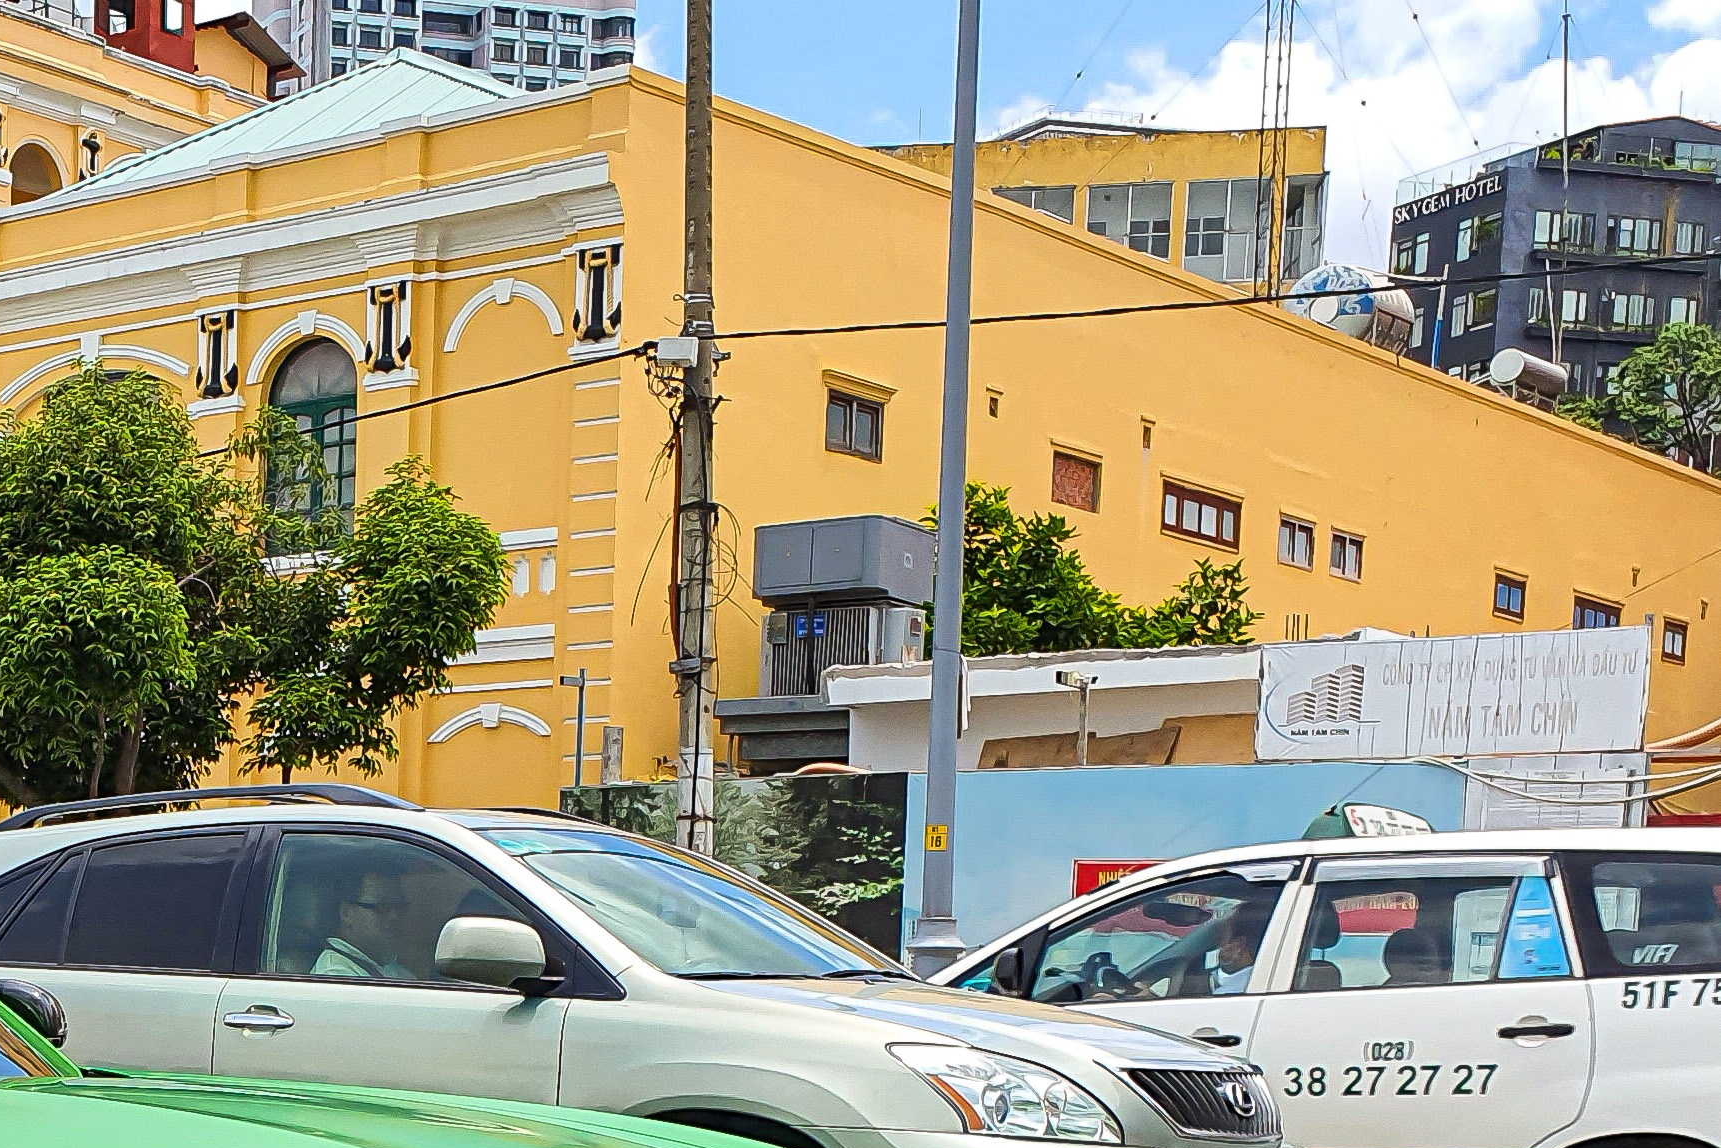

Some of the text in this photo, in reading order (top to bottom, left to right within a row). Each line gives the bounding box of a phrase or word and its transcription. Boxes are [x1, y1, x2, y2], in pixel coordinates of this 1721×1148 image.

[1454, 175, 1503, 205] HOTEL
[1620, 980, 1681, 1010] 51F
[1363, 1040, 1415, 1062] (028)
[1283, 1063, 1499, 1097] 38 27 27 27
